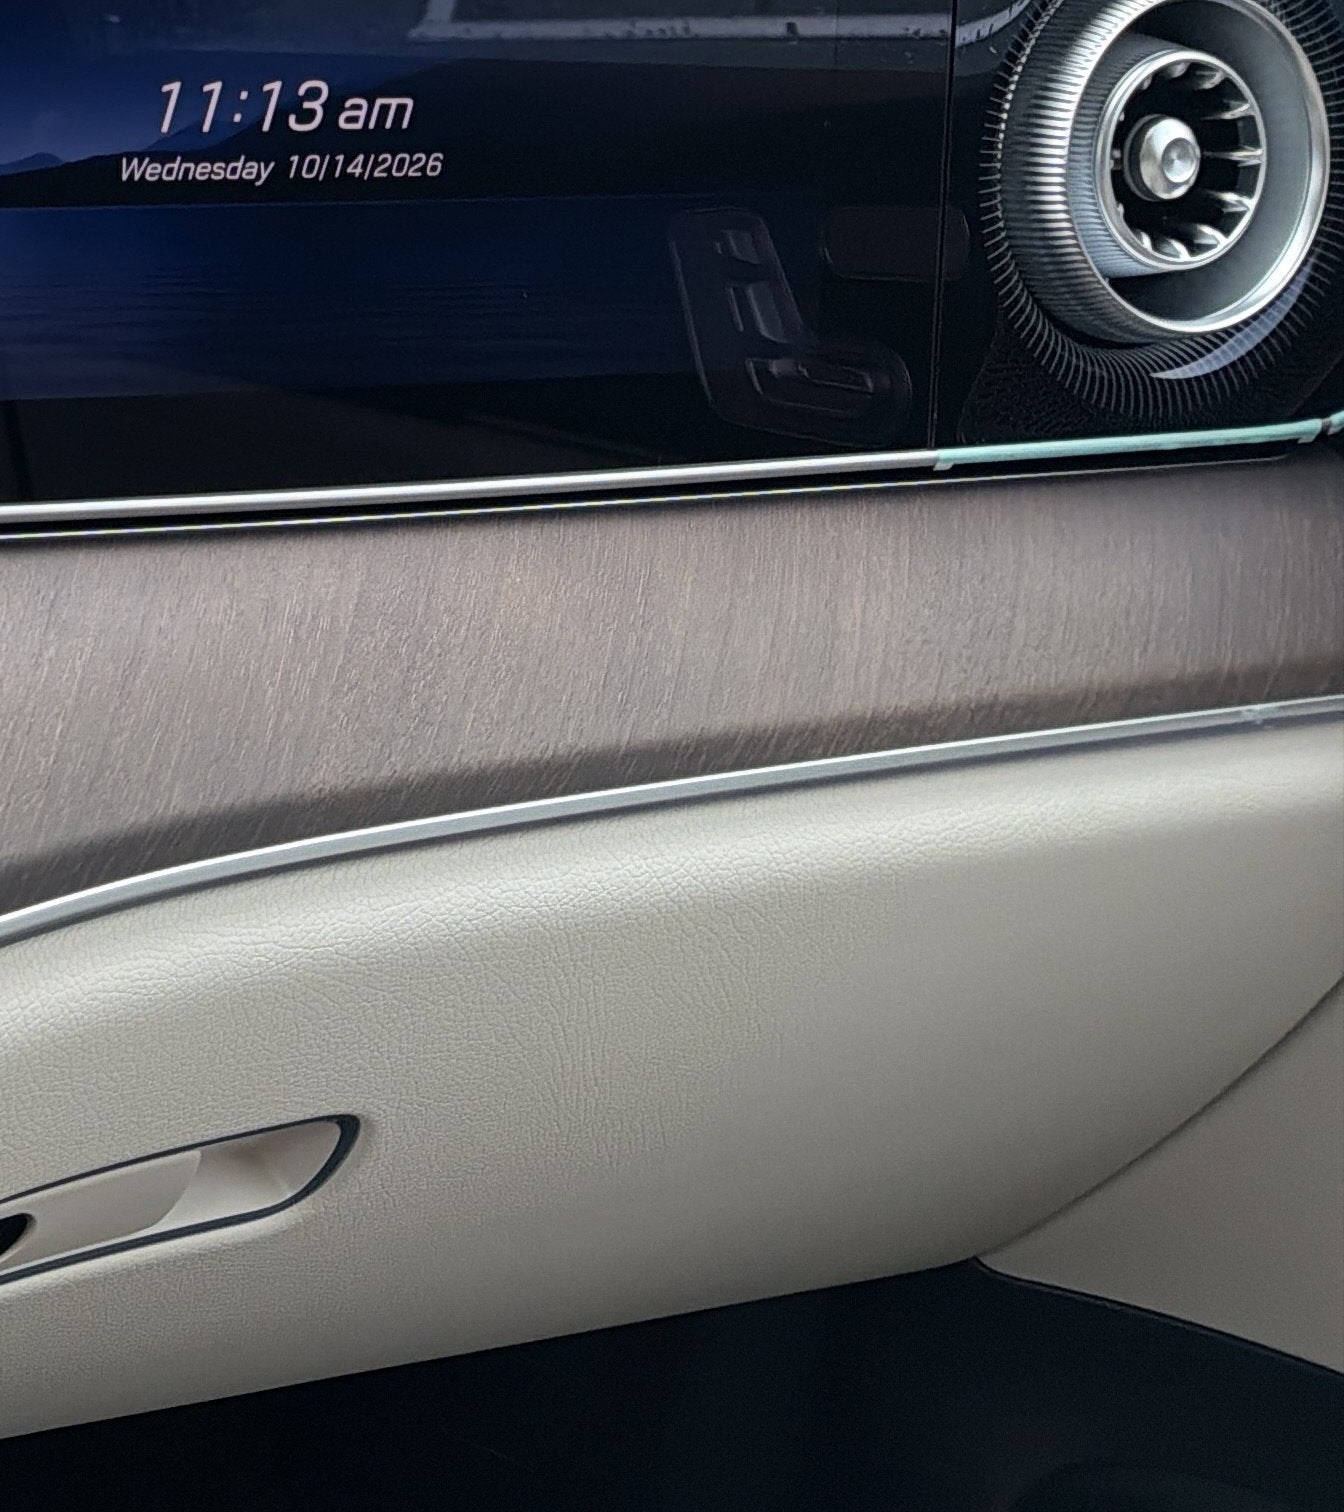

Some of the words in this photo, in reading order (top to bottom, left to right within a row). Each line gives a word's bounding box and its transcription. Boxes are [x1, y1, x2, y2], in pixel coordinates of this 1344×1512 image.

[160, 80, 329, 134] 11:13
[338, 97, 414, 130] am
[121, 154, 275, 186] Wednesday
[288, 152, 444, 181] 10/14/2026
